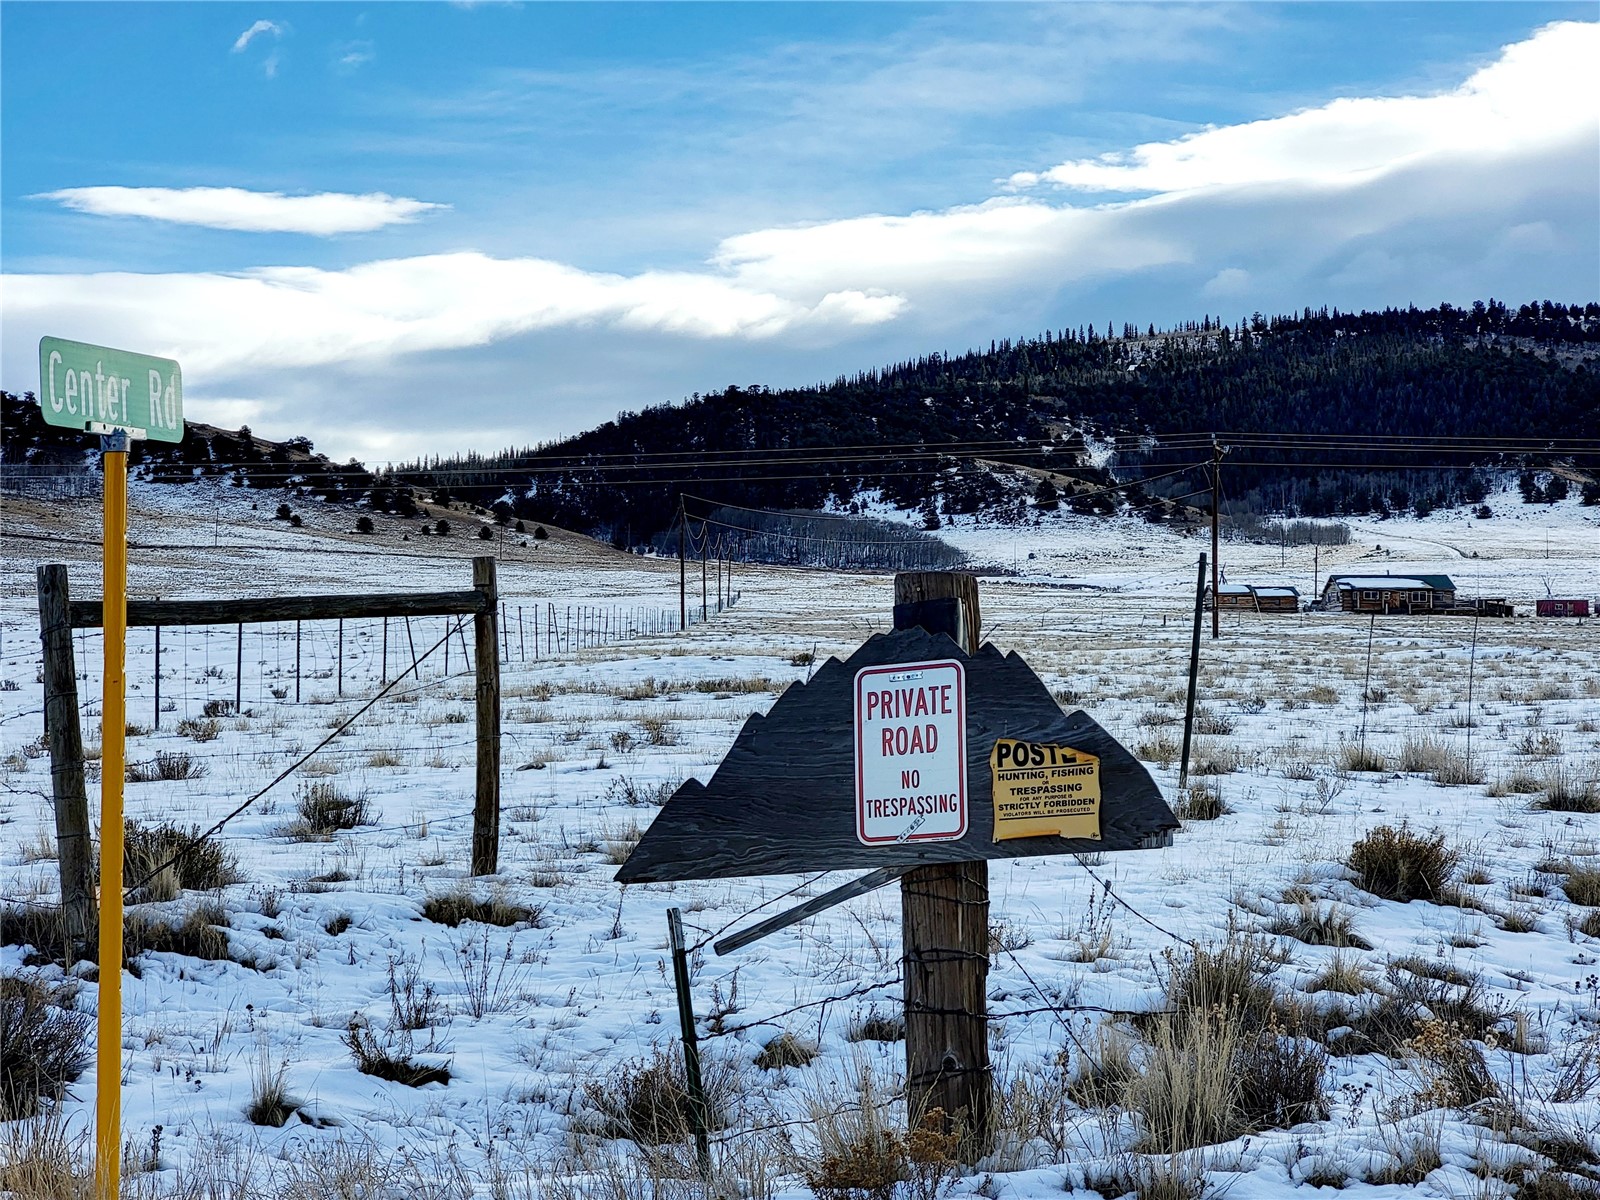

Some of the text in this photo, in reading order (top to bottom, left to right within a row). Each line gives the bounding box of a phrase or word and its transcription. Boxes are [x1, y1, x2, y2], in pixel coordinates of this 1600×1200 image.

[49, 350, 177, 430] Center Rd
[867, 685, 952, 720] PRIVATE
[882, 724, 938, 757] ROAD
[997, 742, 1077, 768] POST
[901, 769, 920, 789] NO
[998, 767, 1094, 781] HUNTING, FISHING
[1010, 783, 1082, 795] TRESPASSING
[866, 793, 958, 818] TRESPASSING
[998, 798, 1095, 812] STRICTLY FORBIDDEN
